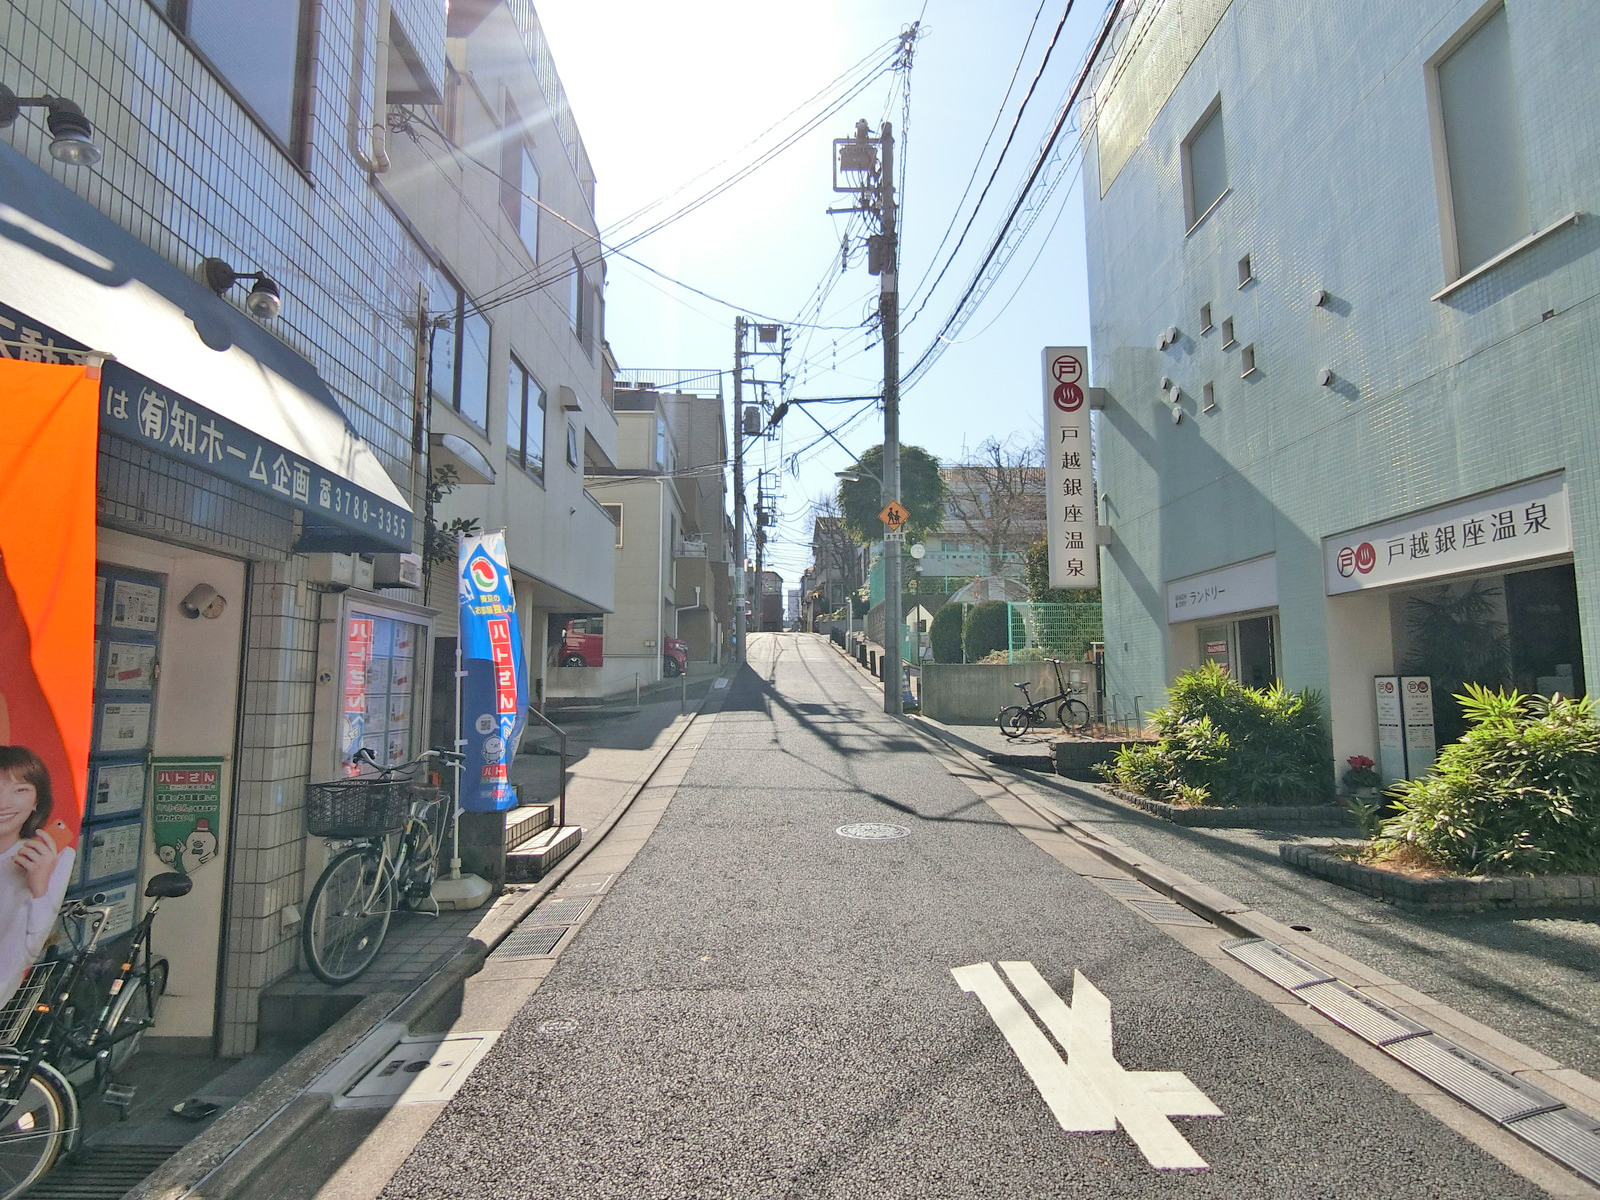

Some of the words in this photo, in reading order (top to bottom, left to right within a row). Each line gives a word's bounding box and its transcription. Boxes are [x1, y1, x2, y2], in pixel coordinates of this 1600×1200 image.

[1060, 426, 1085, 577] 戸越銀座温泉
[1387, 503, 1551, 566] 戸越銀座温泉
[1190, 586, 1226, 605] ランドリー
[160, 773, 215, 782] ハトさん
